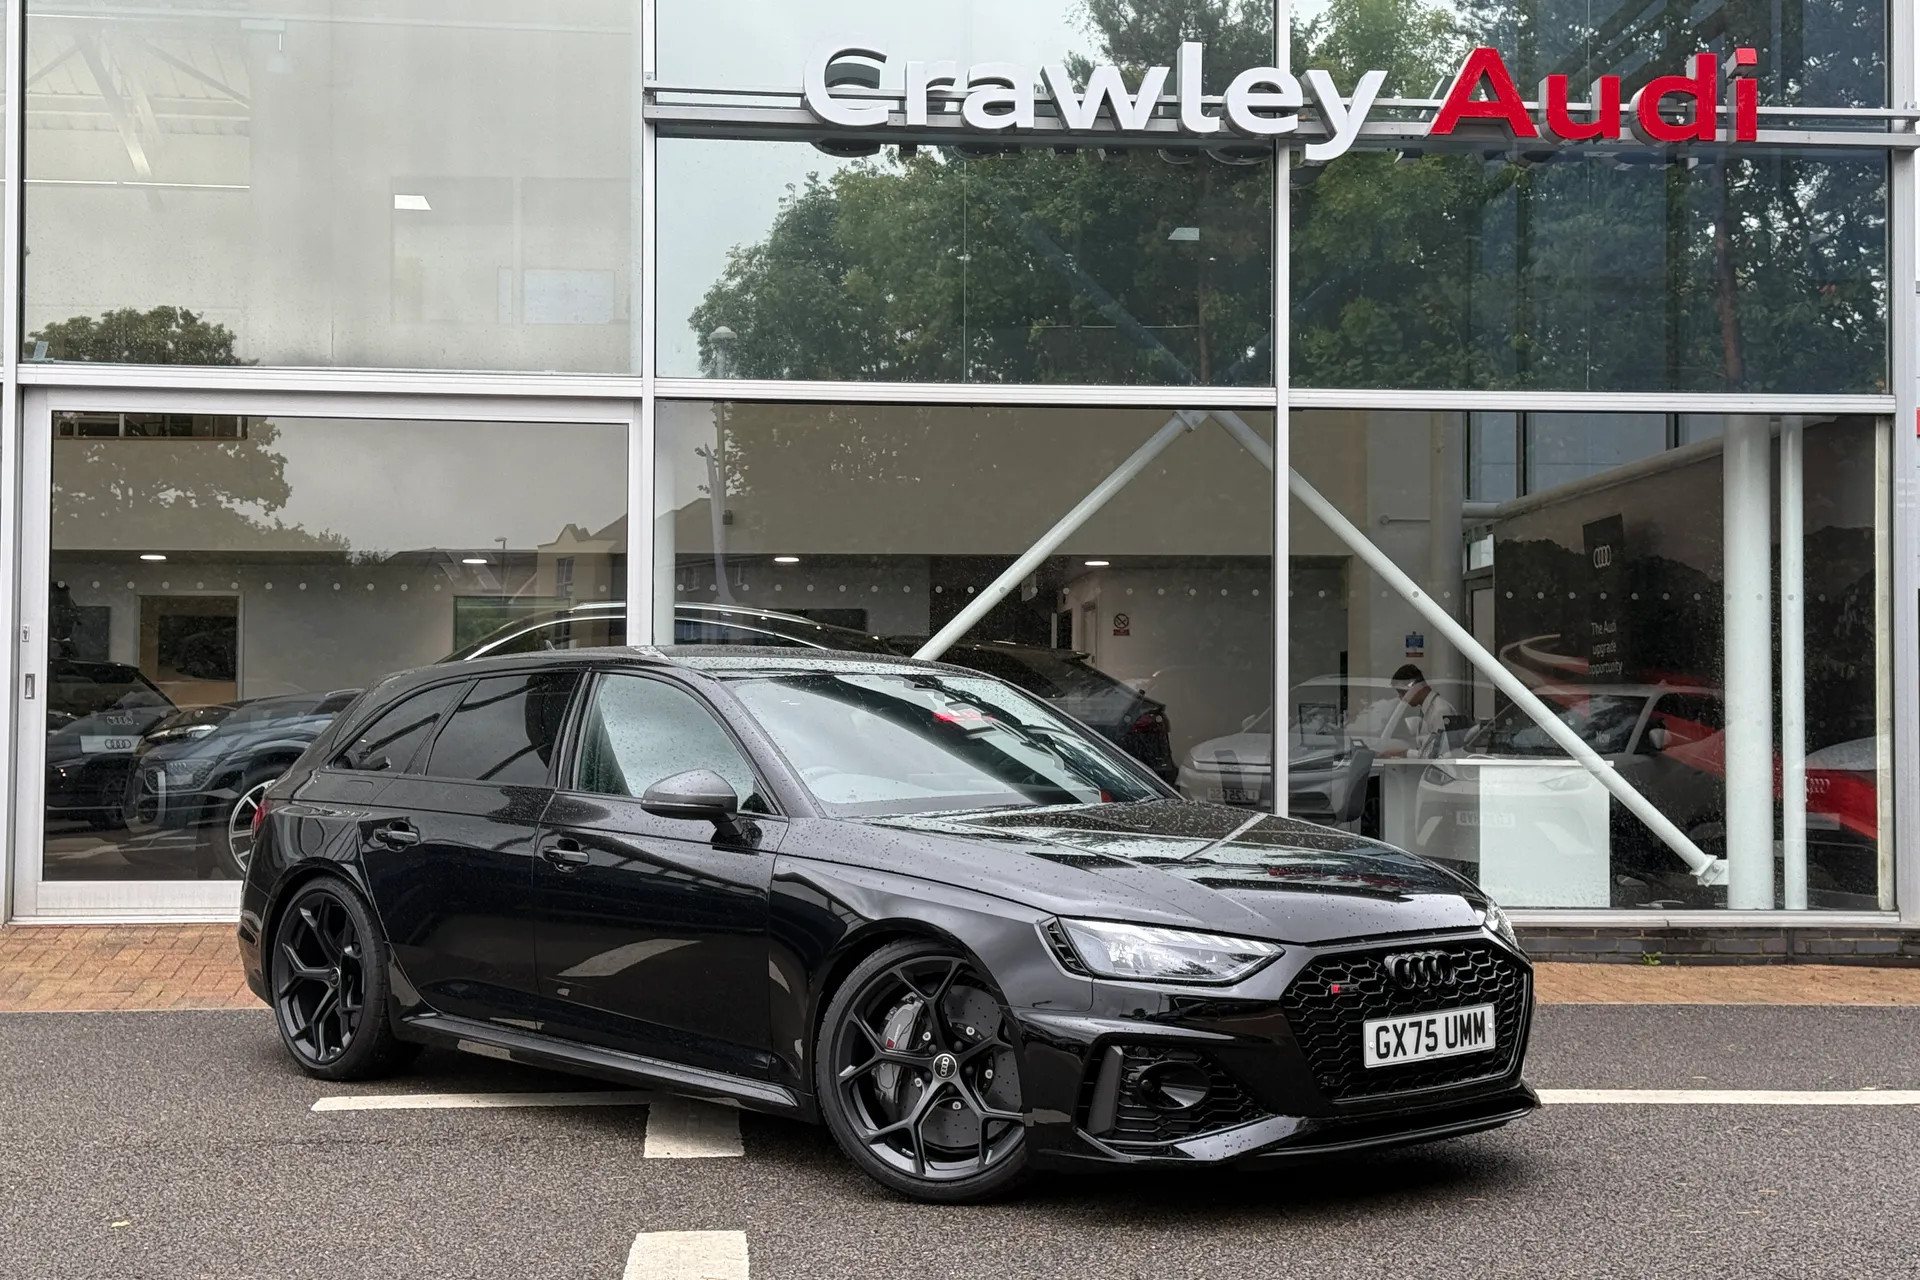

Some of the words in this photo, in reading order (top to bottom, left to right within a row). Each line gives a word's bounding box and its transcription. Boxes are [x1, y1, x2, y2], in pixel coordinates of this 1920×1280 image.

[803, 41, 1388, 161] Crawley
[1428, 47, 1758, 143] Audi
[1591, 622, 1603, 635] The
[1604, 619, 1617, 632] Audi
[1592, 639, 1617, 657] upgrade
[1375, 1019, 1438, 1059] GX75
[1444, 1011, 1486, 1049] UMM
